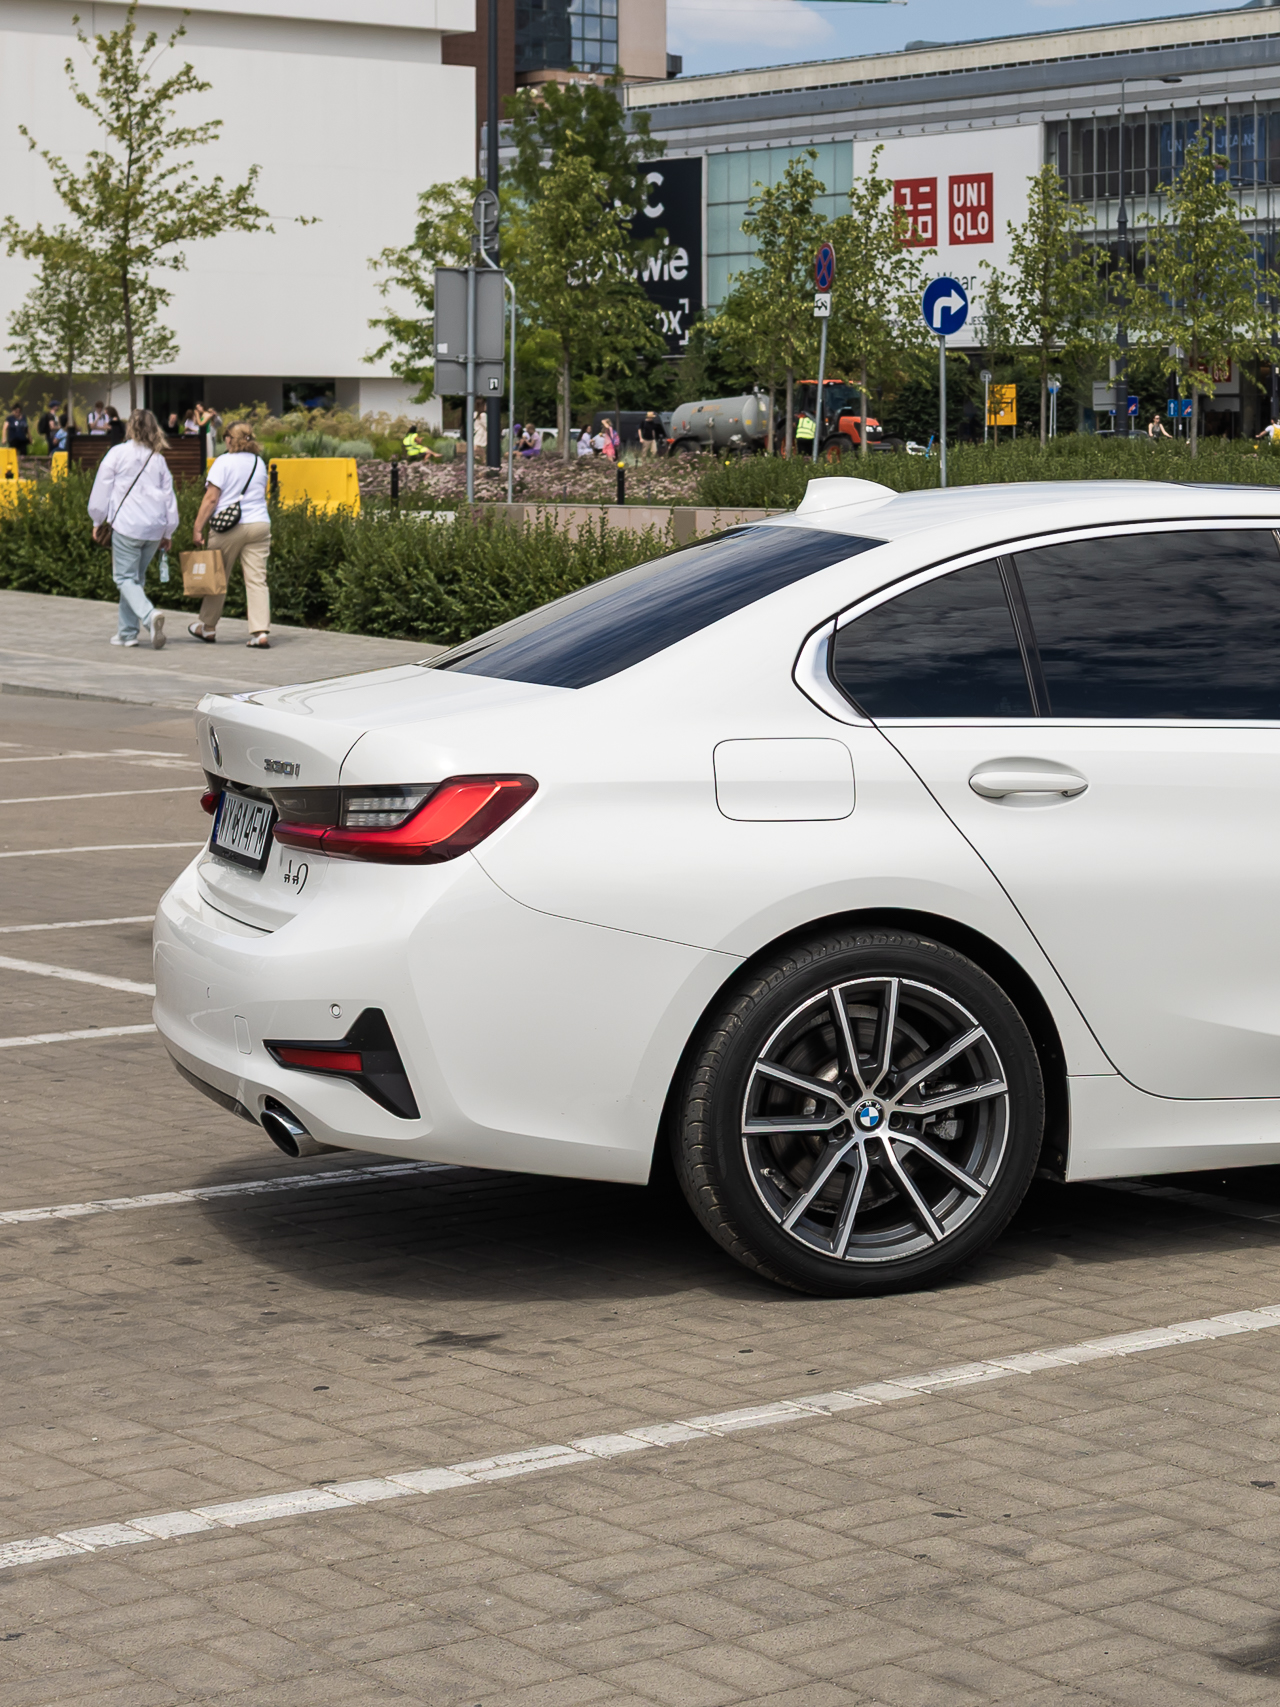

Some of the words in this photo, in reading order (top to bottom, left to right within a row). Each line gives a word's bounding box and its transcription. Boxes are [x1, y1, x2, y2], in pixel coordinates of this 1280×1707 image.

[953, 182, 986, 208] UNI
[953, 211, 989, 241] QLO
[263, 758, 301, 776] 330i
